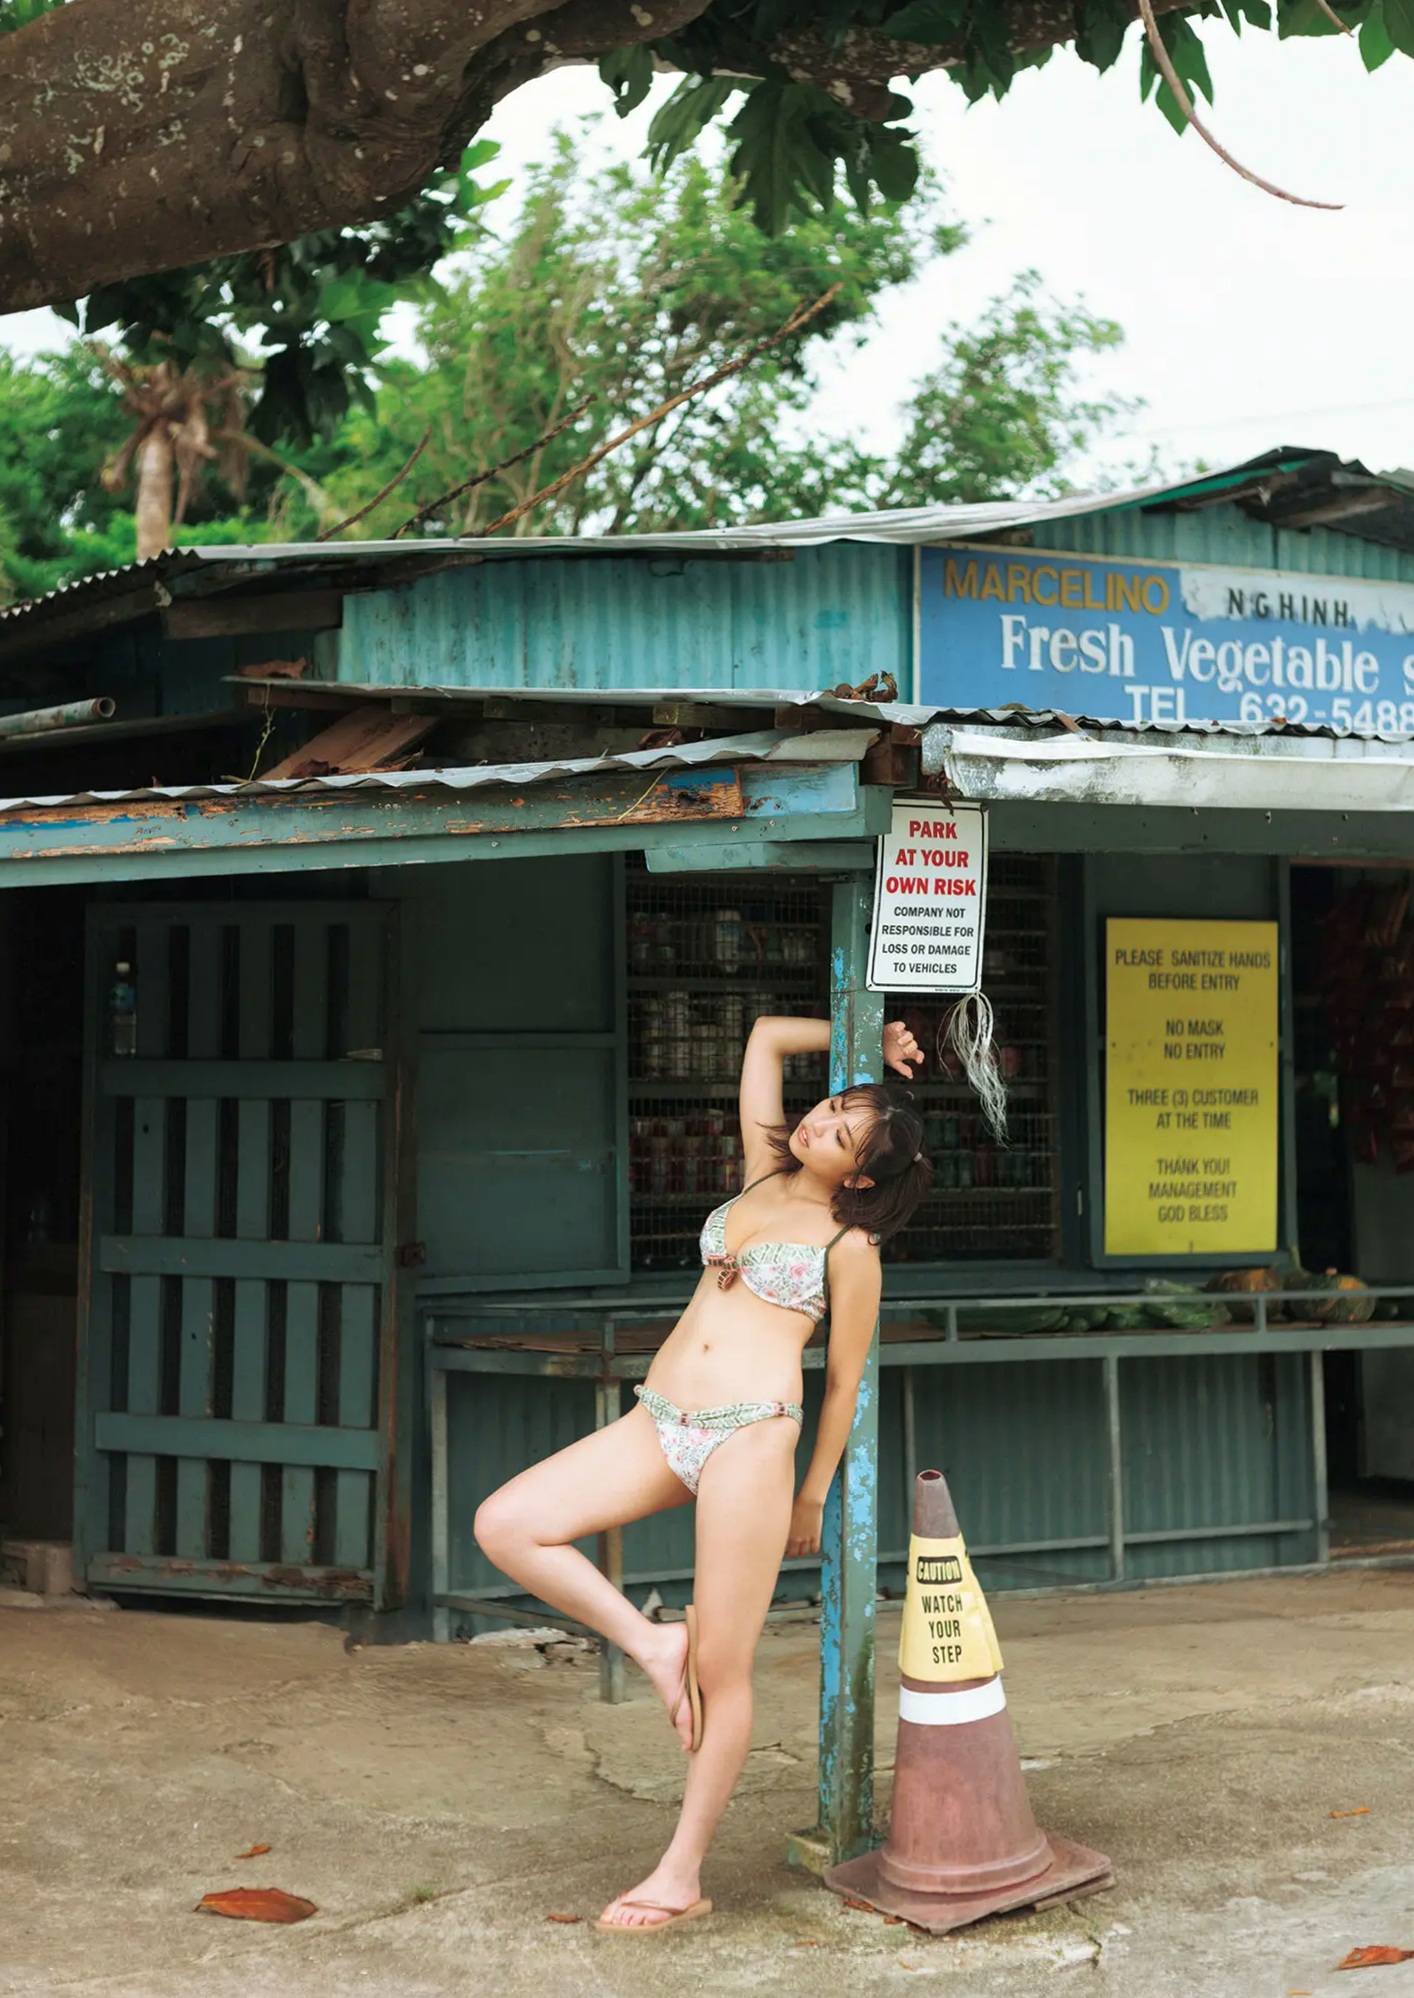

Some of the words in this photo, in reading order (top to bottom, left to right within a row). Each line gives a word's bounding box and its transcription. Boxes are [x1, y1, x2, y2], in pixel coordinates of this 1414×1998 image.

[944, 559, 1170, 615] MARCELINO
[1000, 614, 1136, 678] Fresh
[1160, 624, 1379, 694] Vegetable
[909, 820, 958, 839] PARK
[895, 848, 917, 866] AT
[920, 850, 969, 868] YOUR
[886, 876, 929, 895] OWN
[934, 878, 976, 896] RISK
[894, 906, 943, 918] COMPANY
[946, 908, 966, 919] NOT
[882, 925, 952, 937] RESPONSIBLE
[954, 927, 974, 938] FOR
[882, 943, 908, 955] LOSS
[911, 944, 926, 956] OR
[928, 945, 971, 956] DAMAGE
[893, 962, 907, 973] TO
[909, 963, 957, 974] VEHICLES
[1115, 949, 1163, 967] PLEASE
[1171, 951, 1225, 968] SANITIZE
[1229, 952, 1271, 969] HANDS
[1148, 973, 1197, 990] BEFORE
[1201, 974, 1240, 990] ENTRY
[1166, 1019, 1184, 1036] NO
[1188, 1020, 1224, 1036] MASK
[1164, 1043, 1182, 1060] NO
[1186, 1044, 1225, 1060] ENTRY
[1128, 1089, 1169, 1106] THREE
[1172, 1089, 1189, 1109] (3)
[1192, 1089, 1259, 1106] CUSTOMER
[1156, 1112, 1172, 1130] AT
[1176, 1112, 1199, 1129] THE
[1202, 1112, 1232, 1129] TIME
[1156, 1158, 1199, 1176] THANK
[1202, 1158, 1231, 1176] YOU!
[1148, 1182, 1237, 1199] MANAGEMENT
[1158, 1205, 1185, 1222] GOD
[1188, 1205, 1228, 1222] BLESS
[918, 1560, 961, 1580] CAUTION
[922, 1595, 963, 1613] WATCH
[929, 1620, 961, 1638] YOUR
[933, 1645, 962, 1664] STEP
